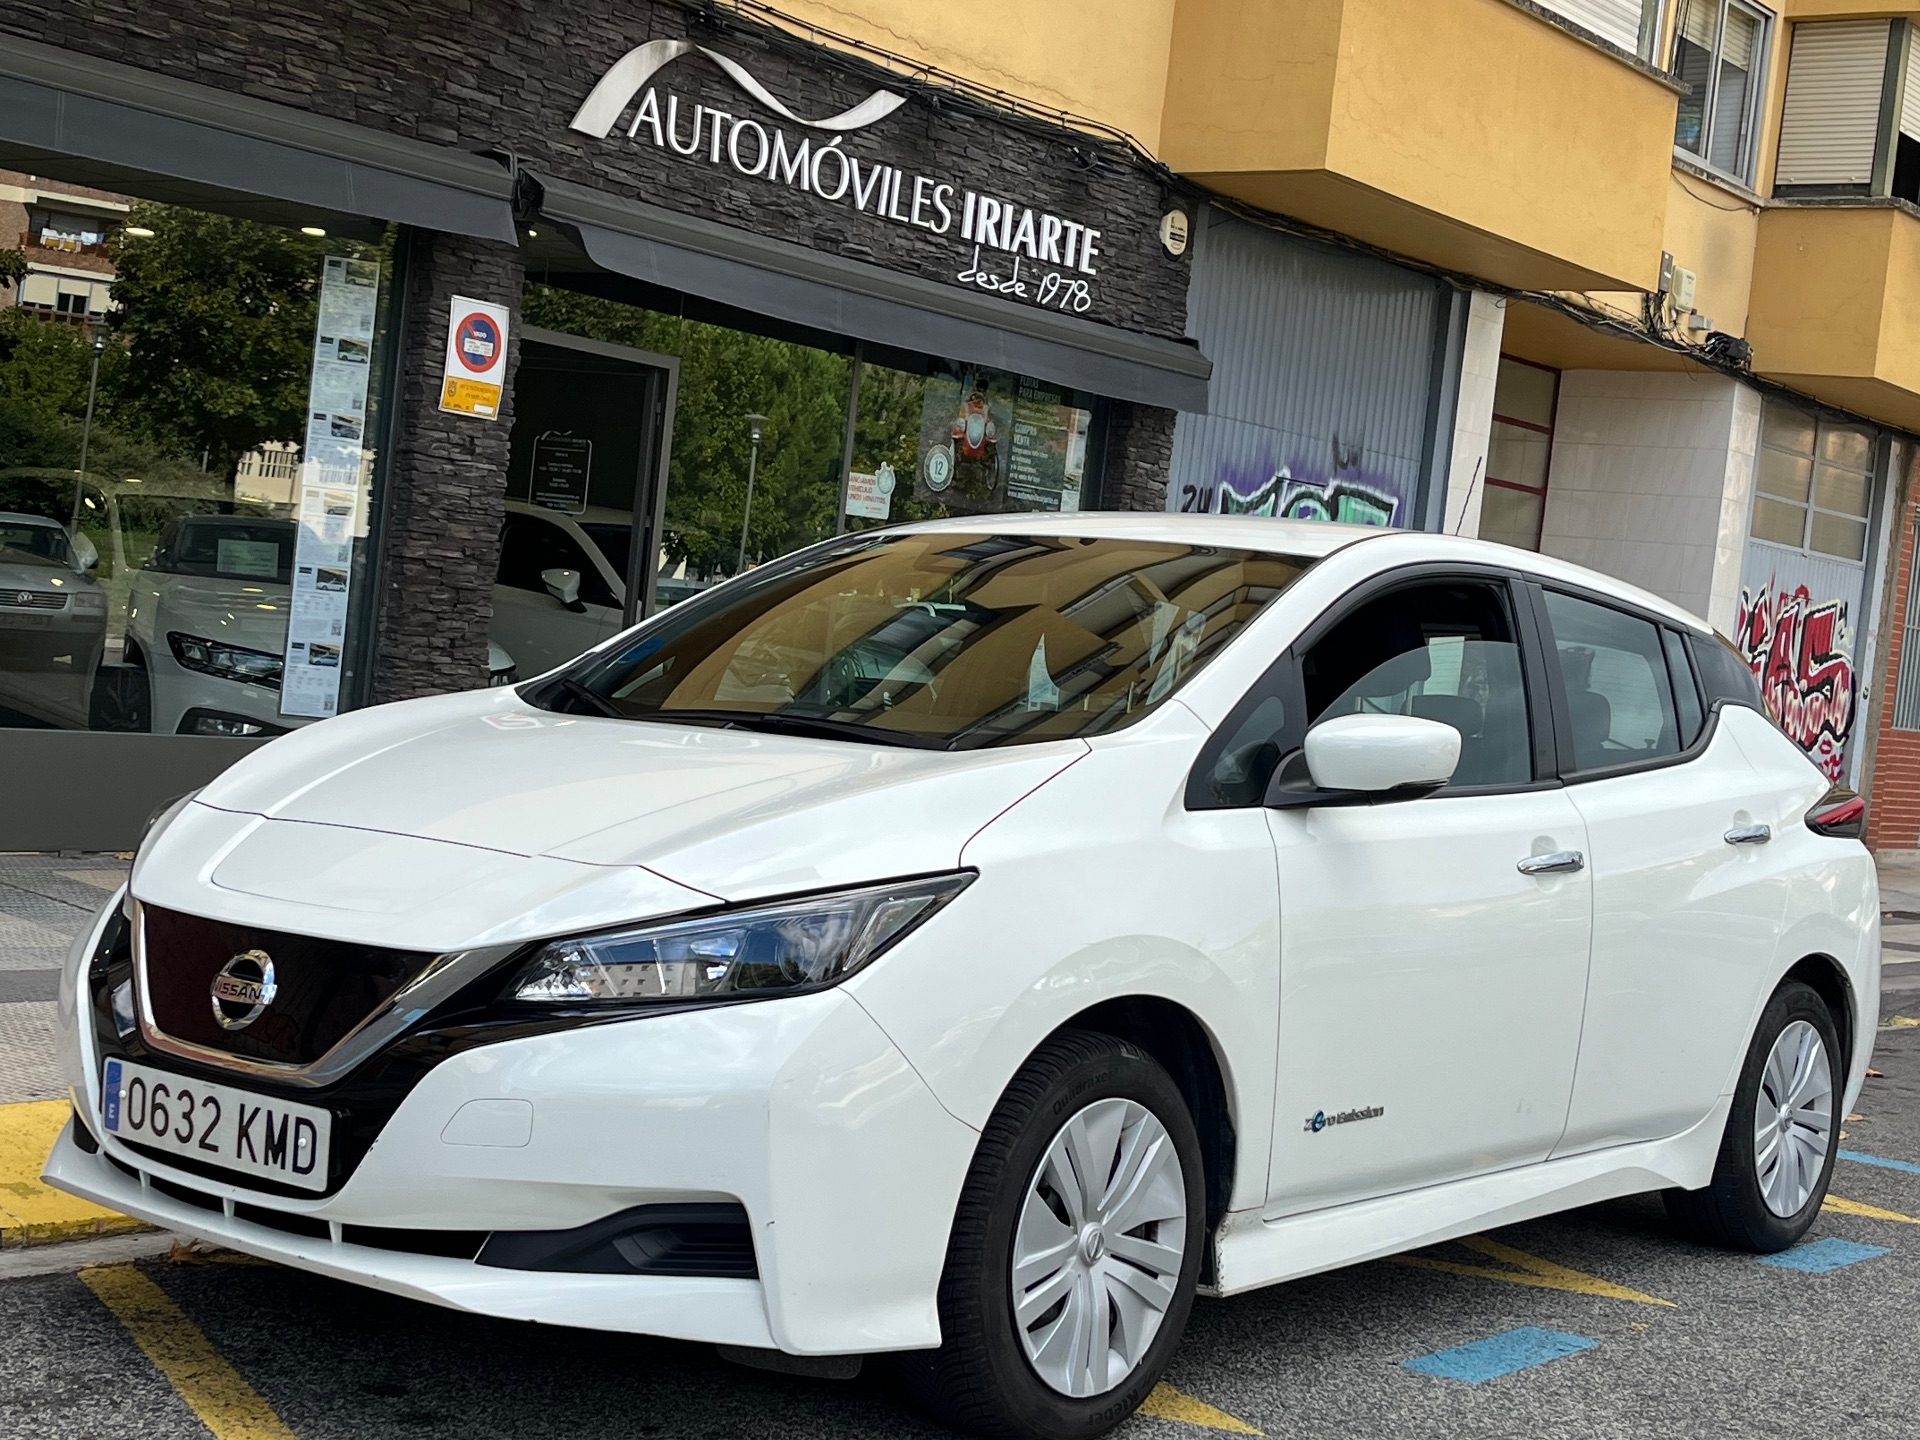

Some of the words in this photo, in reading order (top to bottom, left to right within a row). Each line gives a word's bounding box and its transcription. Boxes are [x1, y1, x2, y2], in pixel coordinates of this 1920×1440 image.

[626, 87, 954, 234] AUTOMÓVILES
[960, 191, 1101, 275] IRIARTE
[957, 245, 1028, 297] desde
[1036, 273, 1091, 312] 1978
[935, 460, 944, 476] 12
[127, 1076, 221, 1153] 0632
[236, 1103, 318, 1176] KMD
